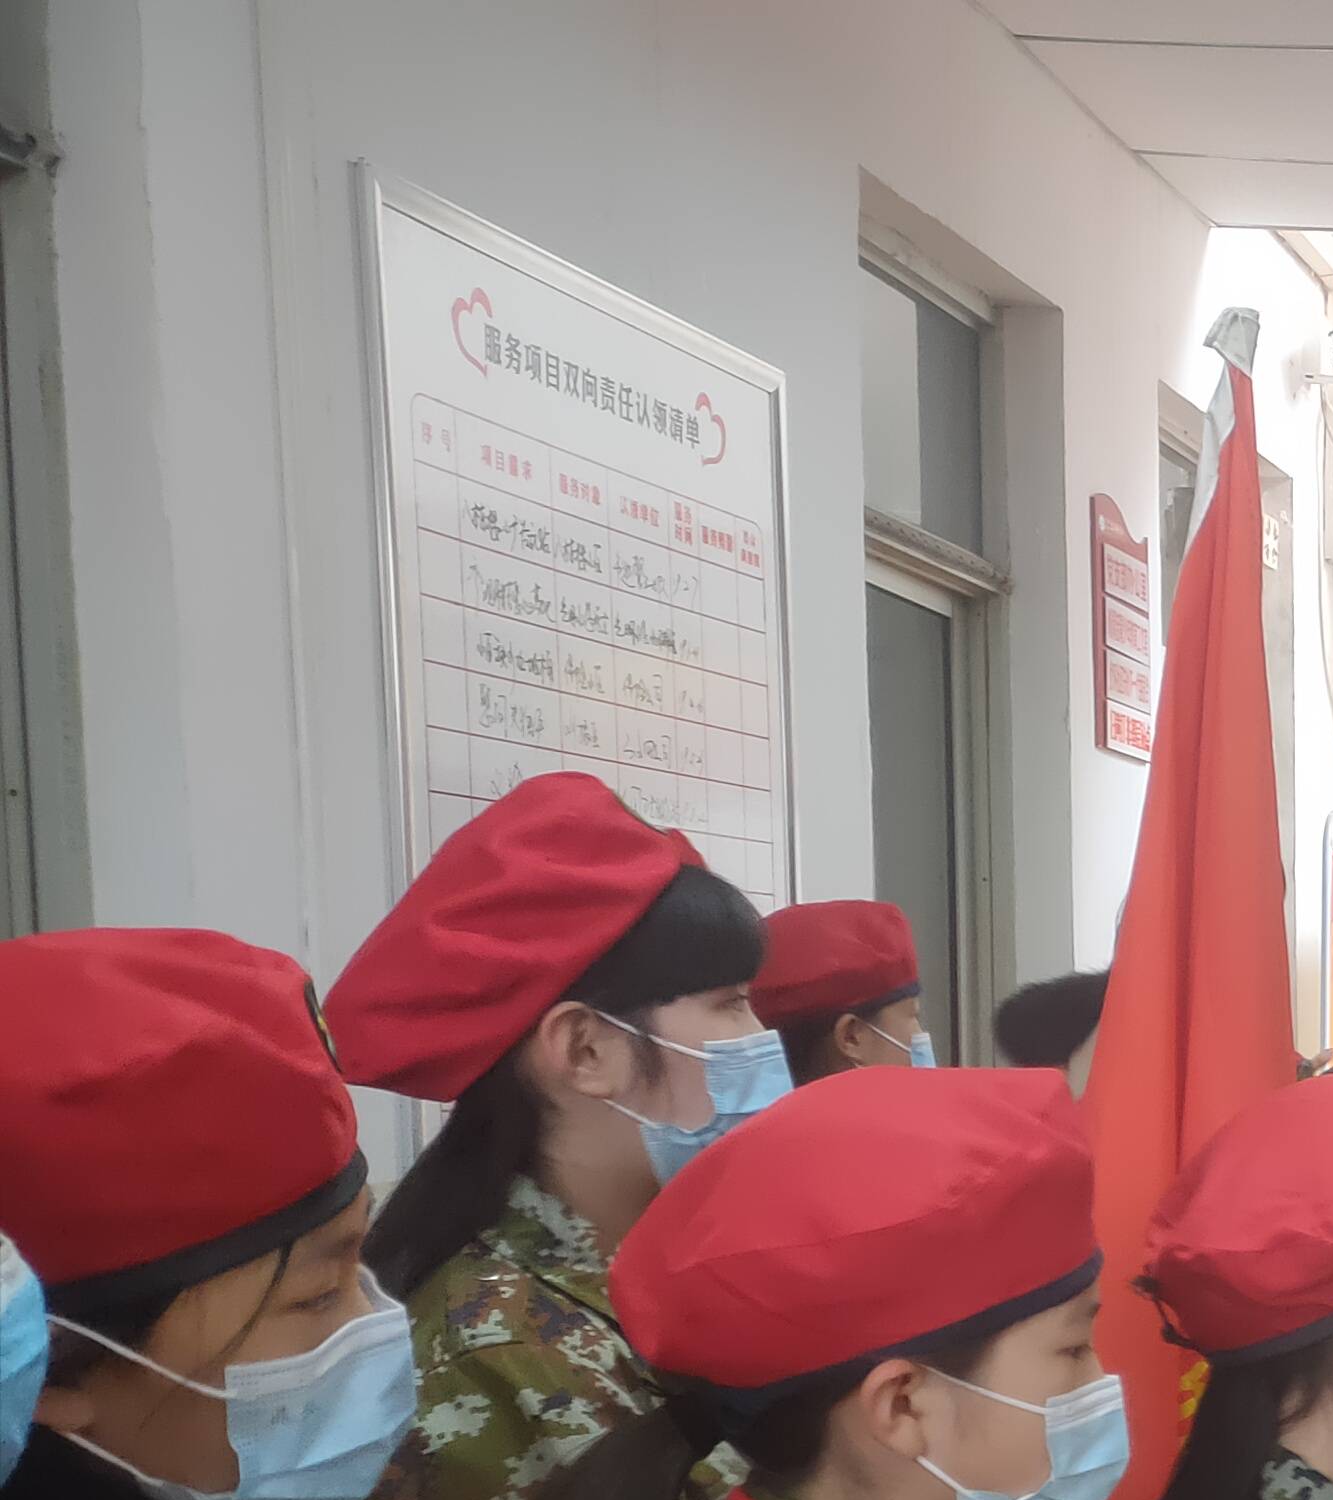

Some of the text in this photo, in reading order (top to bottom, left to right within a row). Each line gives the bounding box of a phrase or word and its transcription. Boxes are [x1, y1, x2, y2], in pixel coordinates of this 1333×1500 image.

[484, 322, 702, 449] 服务项目双向责任认领清单
